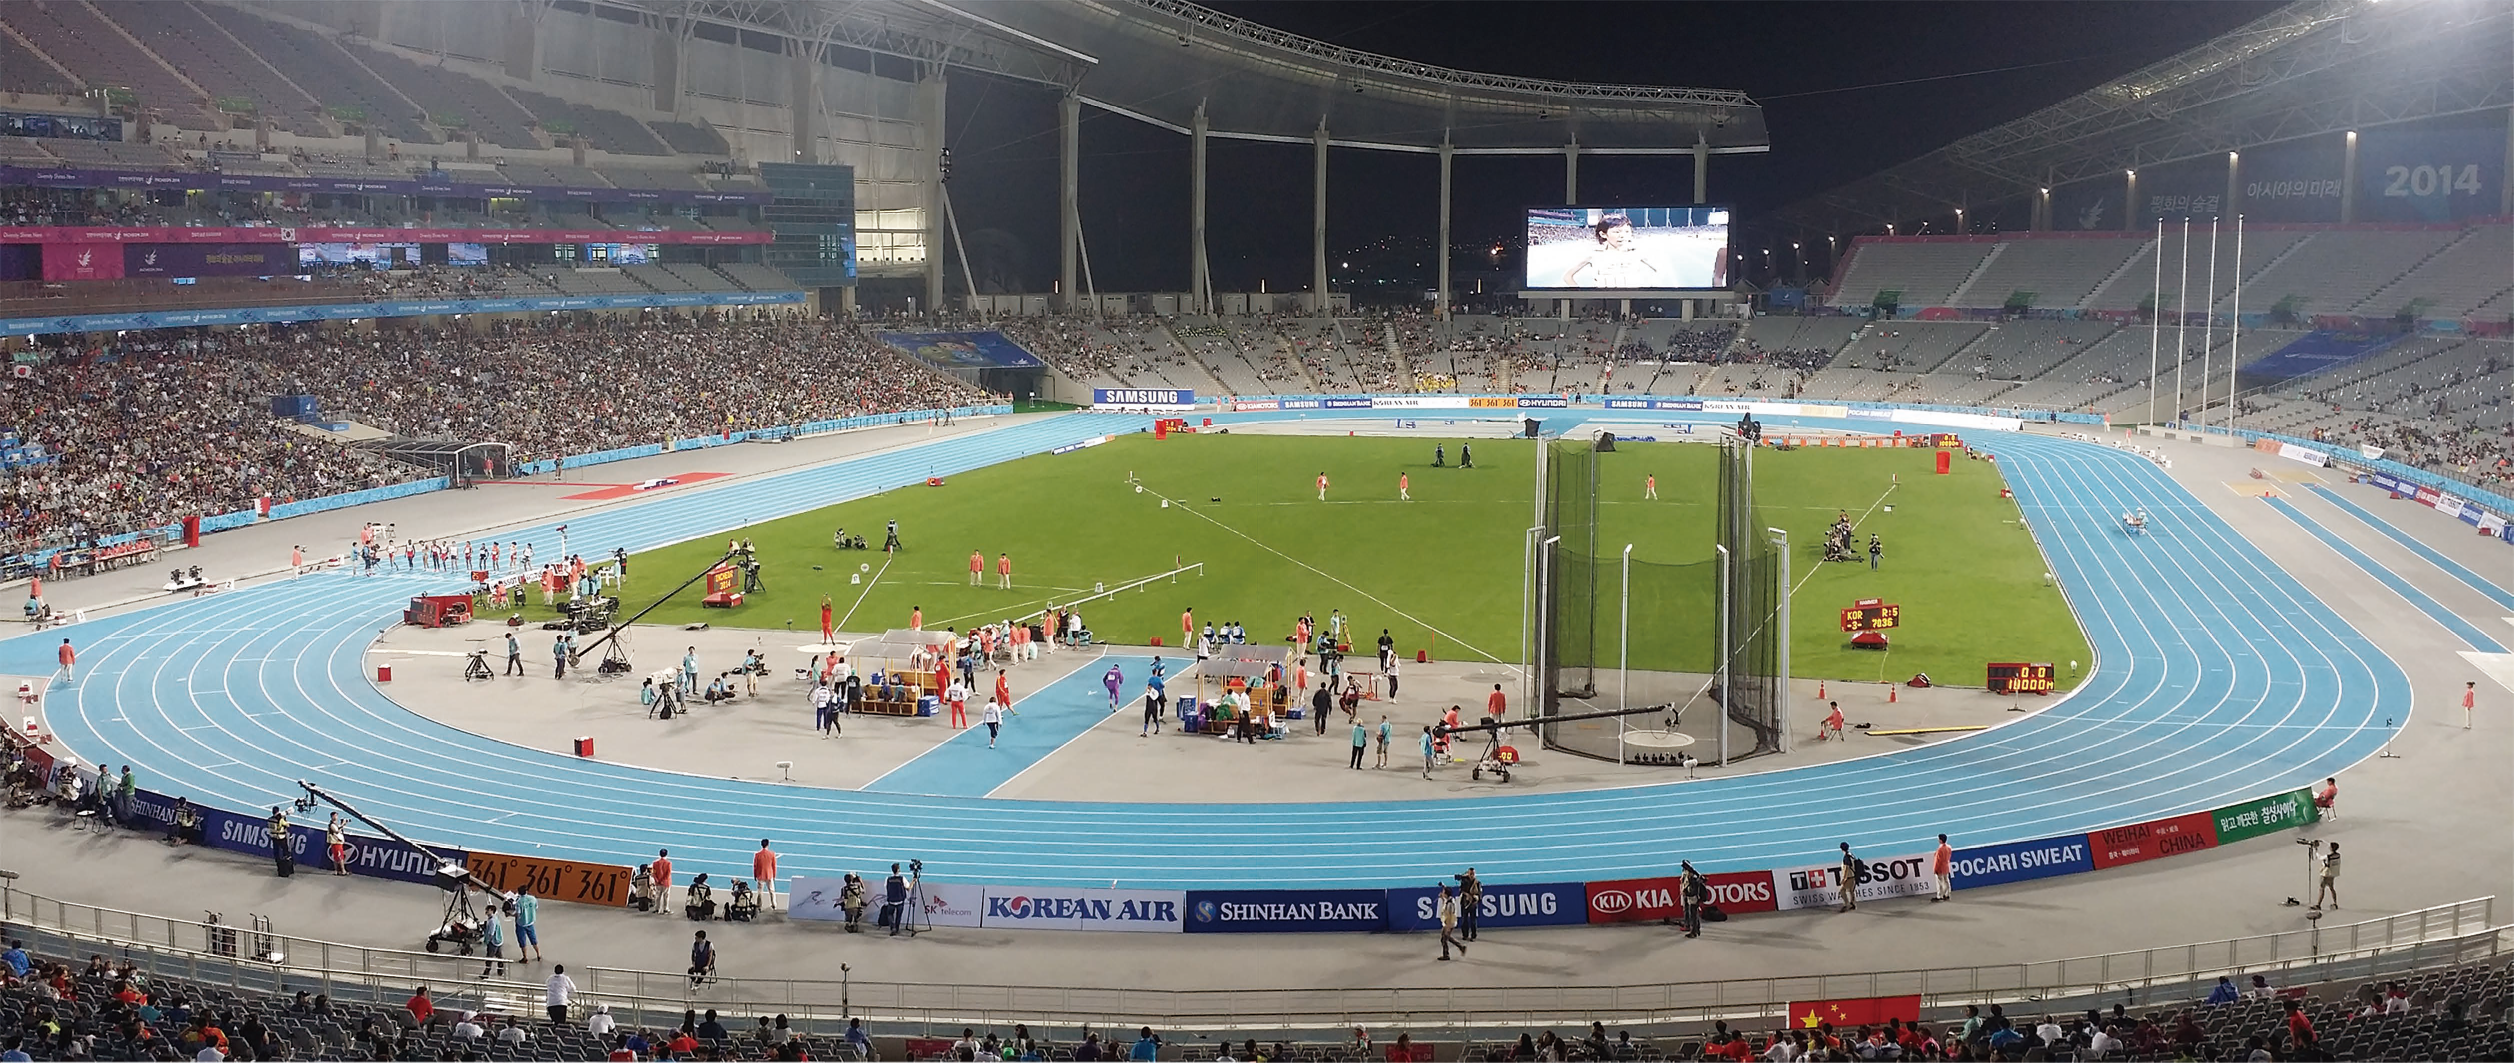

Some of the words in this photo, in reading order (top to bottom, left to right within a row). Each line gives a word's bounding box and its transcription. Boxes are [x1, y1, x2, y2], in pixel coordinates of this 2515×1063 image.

[2248, 180, 2307, 199] 아시아의
[2309, 178, 2343, 198] 미래
[2385, 163, 2482, 197] 2014
[1106, 390, 1178, 404] SAMSUNG
[1285, 401, 1319, 409] SAMSUNG
[1611, 400, 1648, 408] SAMSUNG
[1847, 610, 1863, 620] KOR
[222, 819, 307, 855] SAMSNG
[2102, 824, 2152, 846] WEIHAI
[2159, 832, 2206, 854] CHINA
[1827, 857, 1924, 887] TSSOT
[1950, 853, 2018, 879] POCARI
[2020, 844, 2083, 871] SWEAT
[1599, 895, 1626, 909] KIA
[1635, 888, 1674, 909] KIA
[1680, 881, 1771, 907] OTORS
[1793, 892, 1825, 905] SWISS
[1828, 888, 1874, 902] WAHES
[1877, 884, 1906, 896] SINCE
[1909, 881, 1930, 892] 1853
[924, 905, 938, 915] SK
[941, 908, 972, 916] telecom
[987, 895, 1112, 921] KOREAN
[1116, 899, 1178, 923] AIR
[1220, 901, 1317, 922] SHINHAN
[1319, 901, 1379, 921] BANK
[1417, 892, 1557, 920] SSUNG
